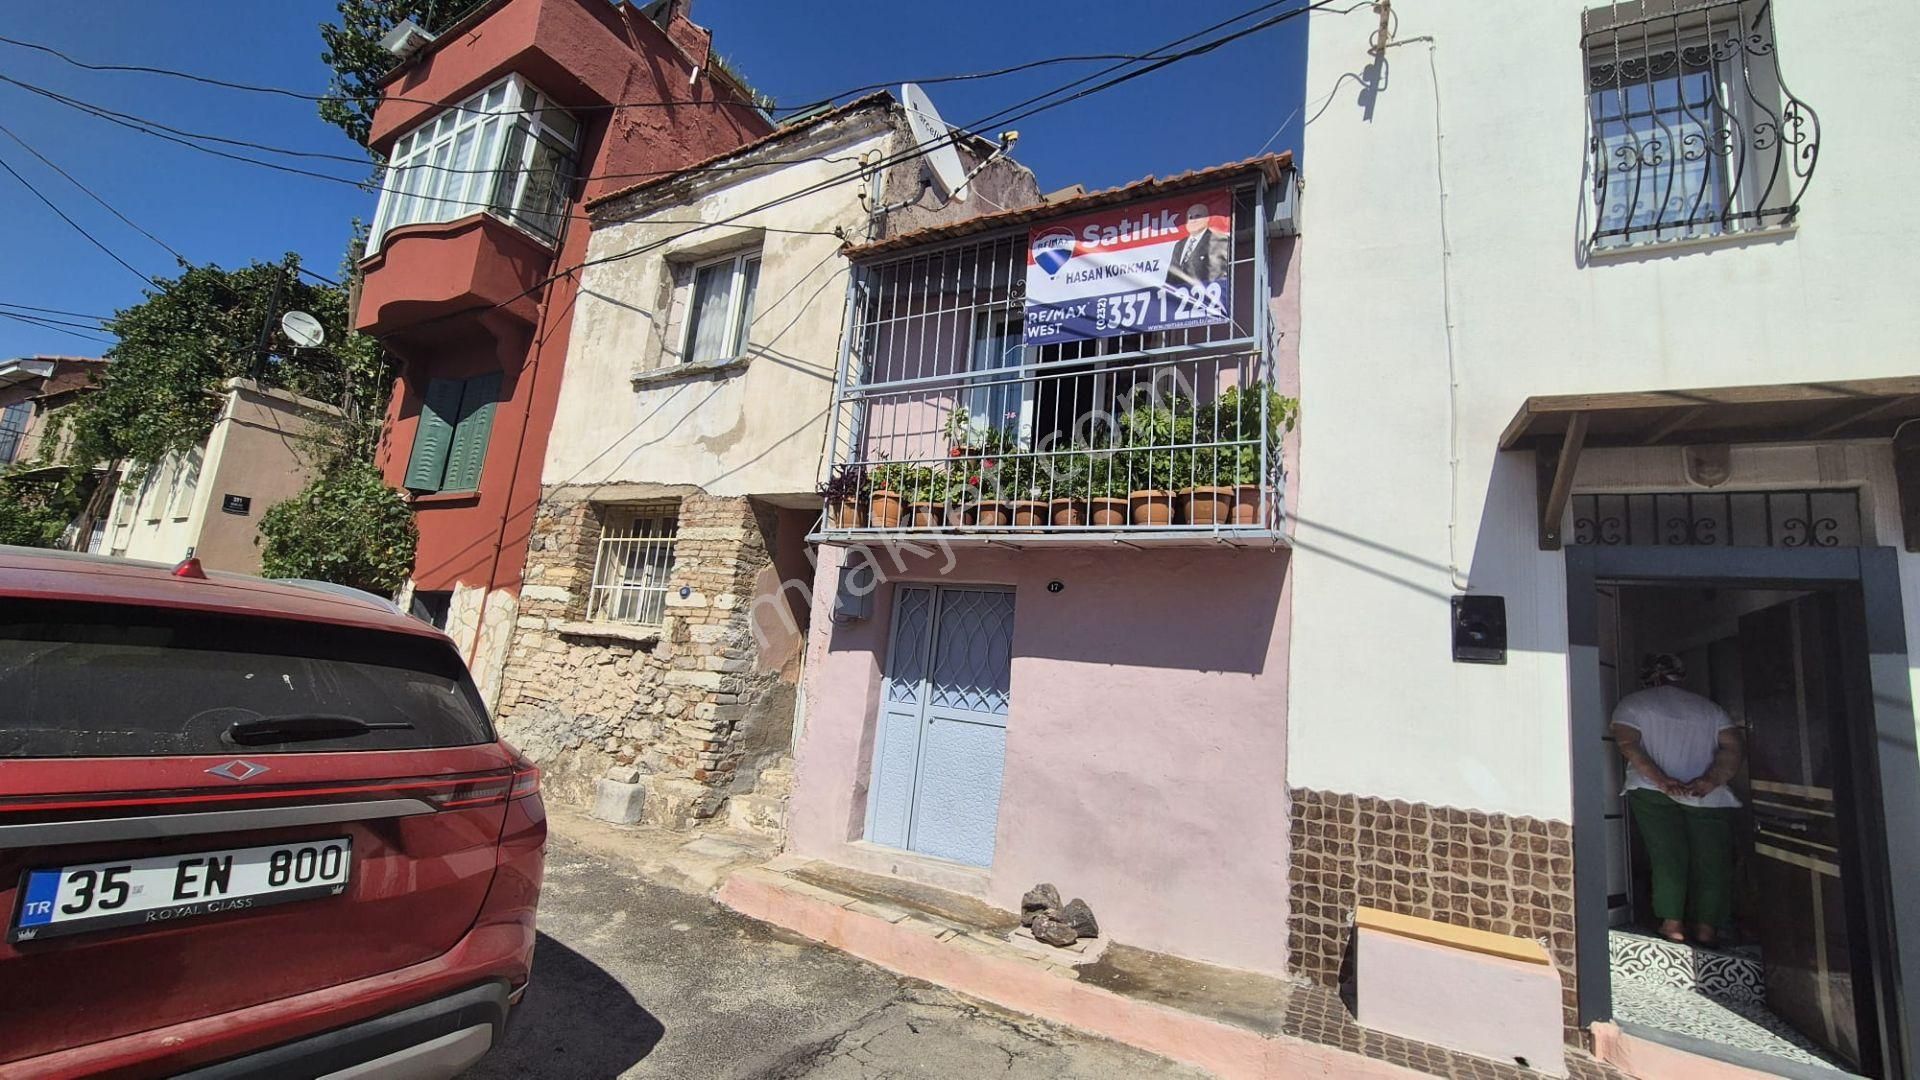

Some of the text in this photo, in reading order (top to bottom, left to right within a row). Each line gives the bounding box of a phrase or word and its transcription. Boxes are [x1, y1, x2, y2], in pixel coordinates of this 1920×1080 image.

[1081, 209, 1180, 249] Satılık
[1066, 258, 1160, 285] HASAN KORKMAZ
[1028, 303, 1087, 322] RE/MAX
[1107, 291, 1151, 329] 337
[1027, 322, 1063, 338] WEST
[61, 844, 343, 915] 35 EN 800
[27, 898, 51, 916] TR
[145, 898, 253, 922] ROYAL CLASS
